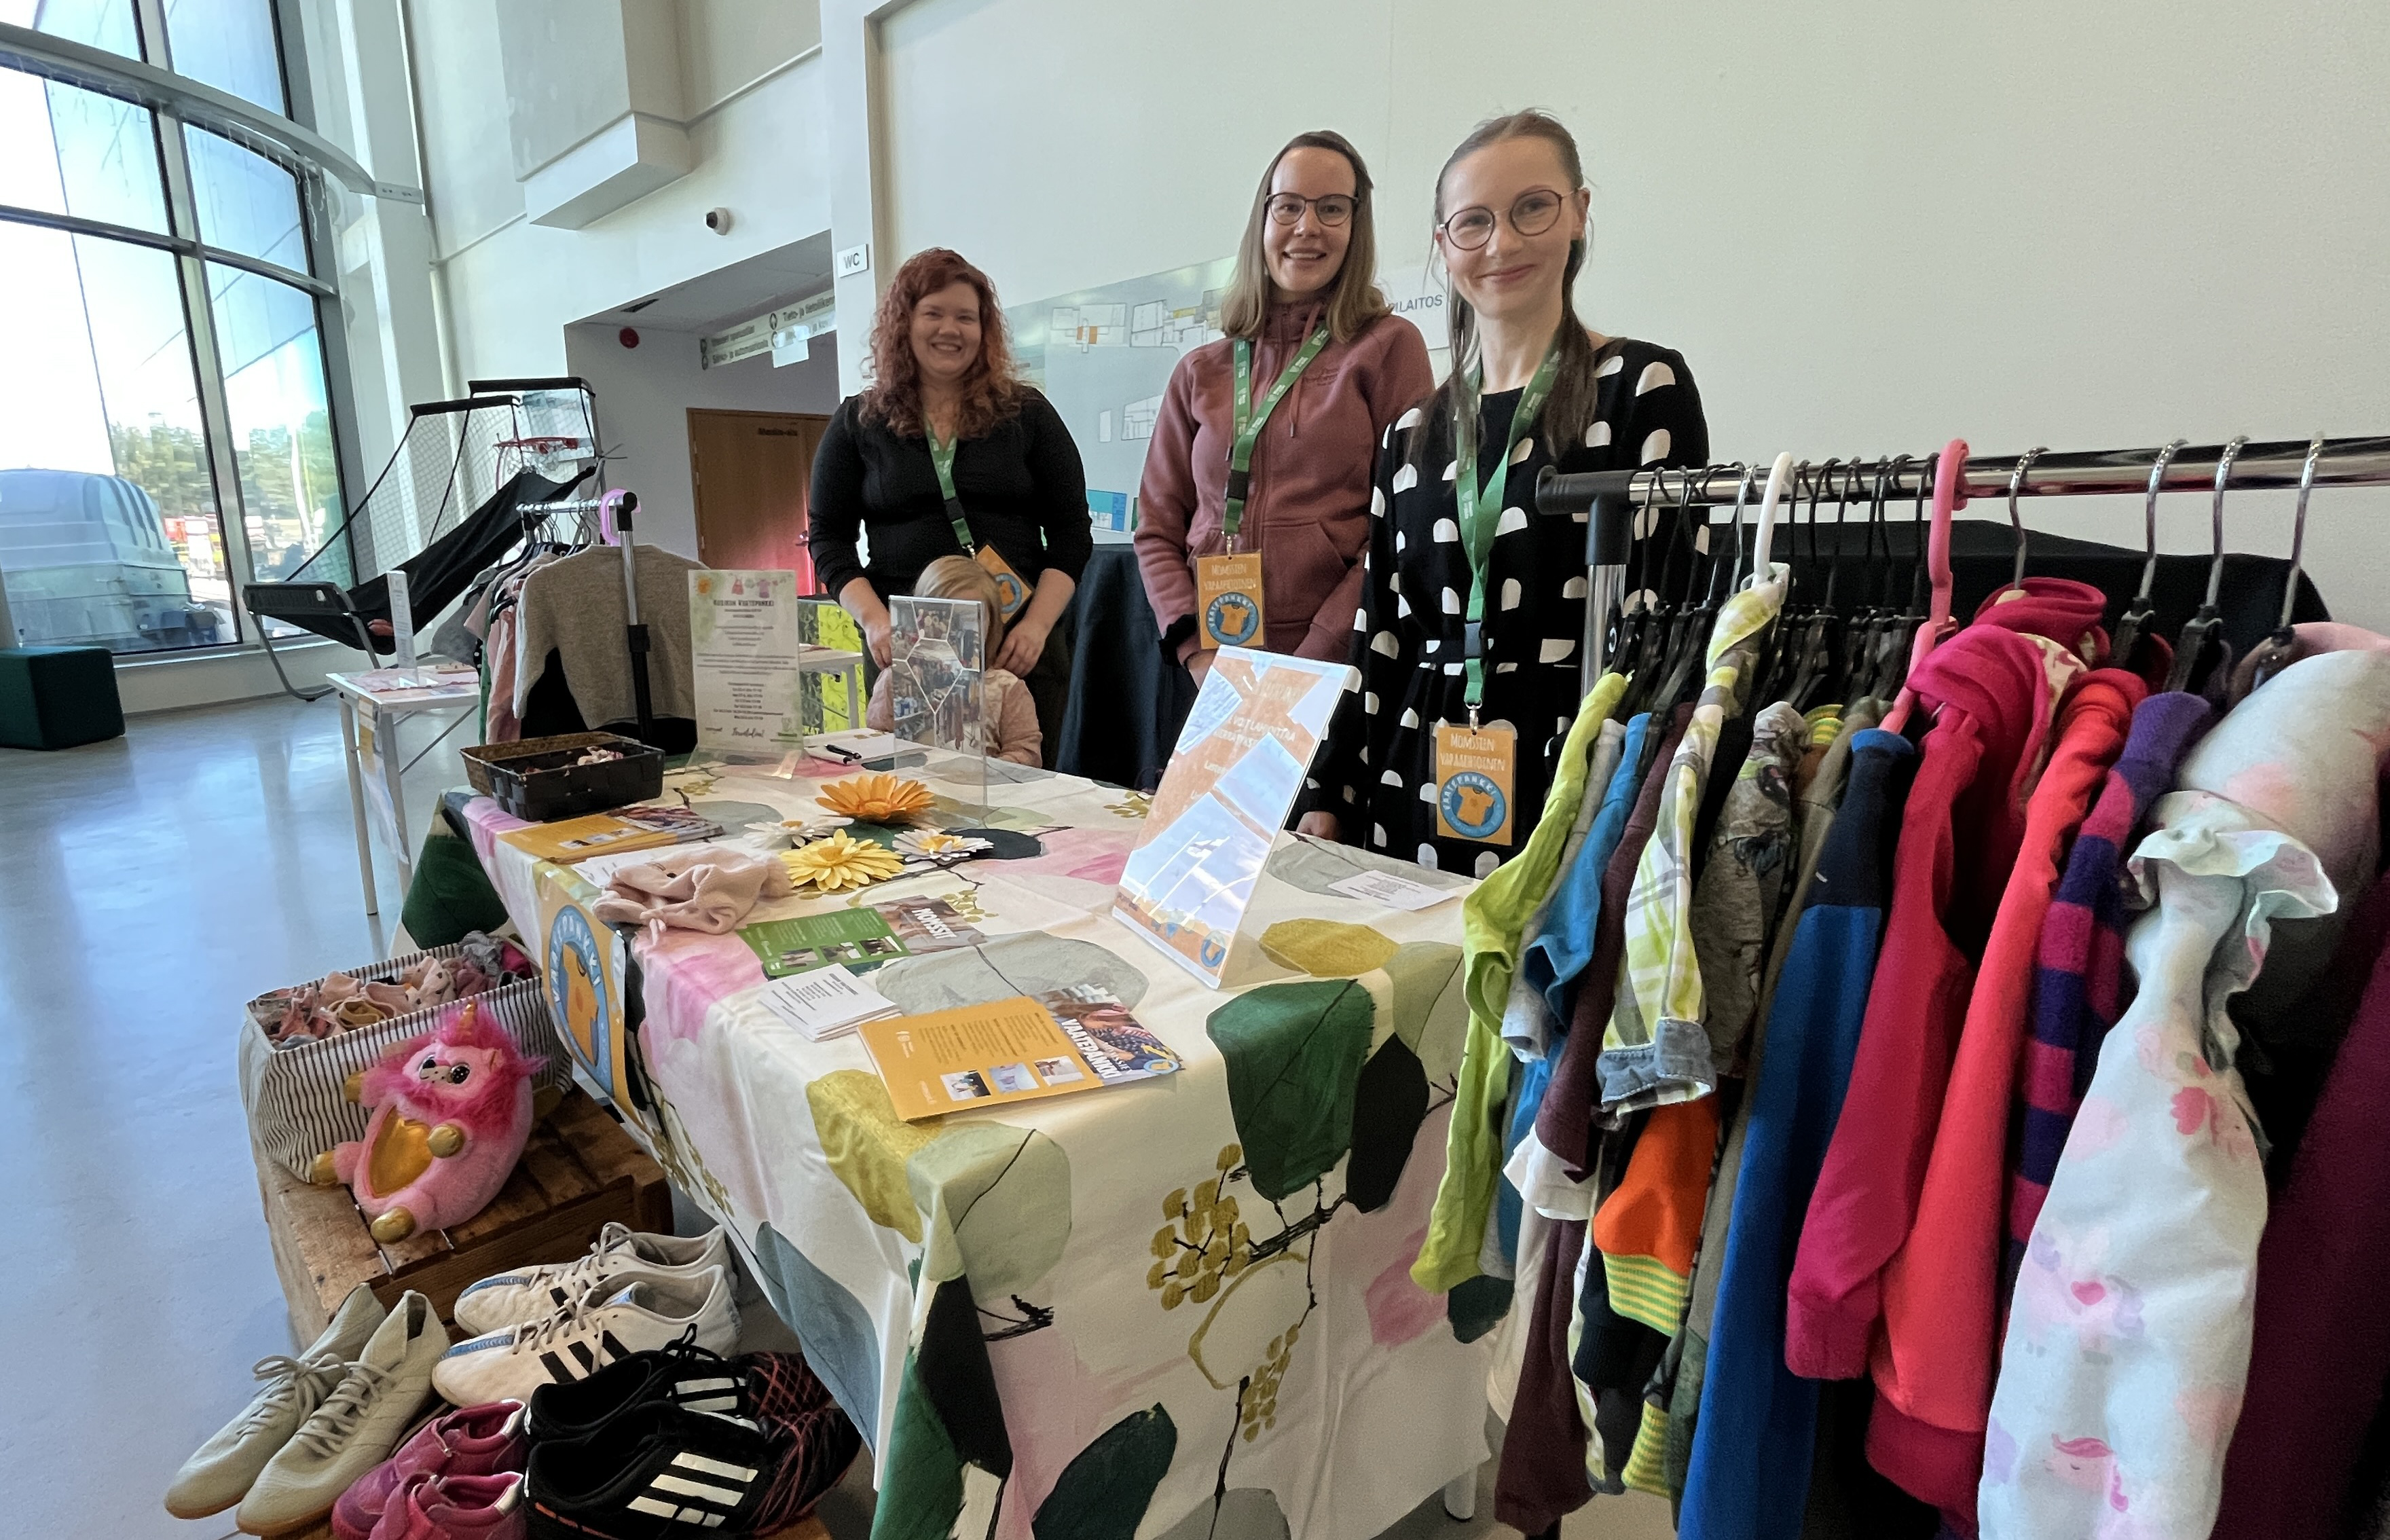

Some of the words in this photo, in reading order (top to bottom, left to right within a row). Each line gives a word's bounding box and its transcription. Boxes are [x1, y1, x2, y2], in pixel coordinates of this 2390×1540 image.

[843, 252, 860, 269] WC
[1443, 775, 1496, 810] VAATEPANKKI
[1061, 1019, 1123, 1079] VAATEPANKKI
